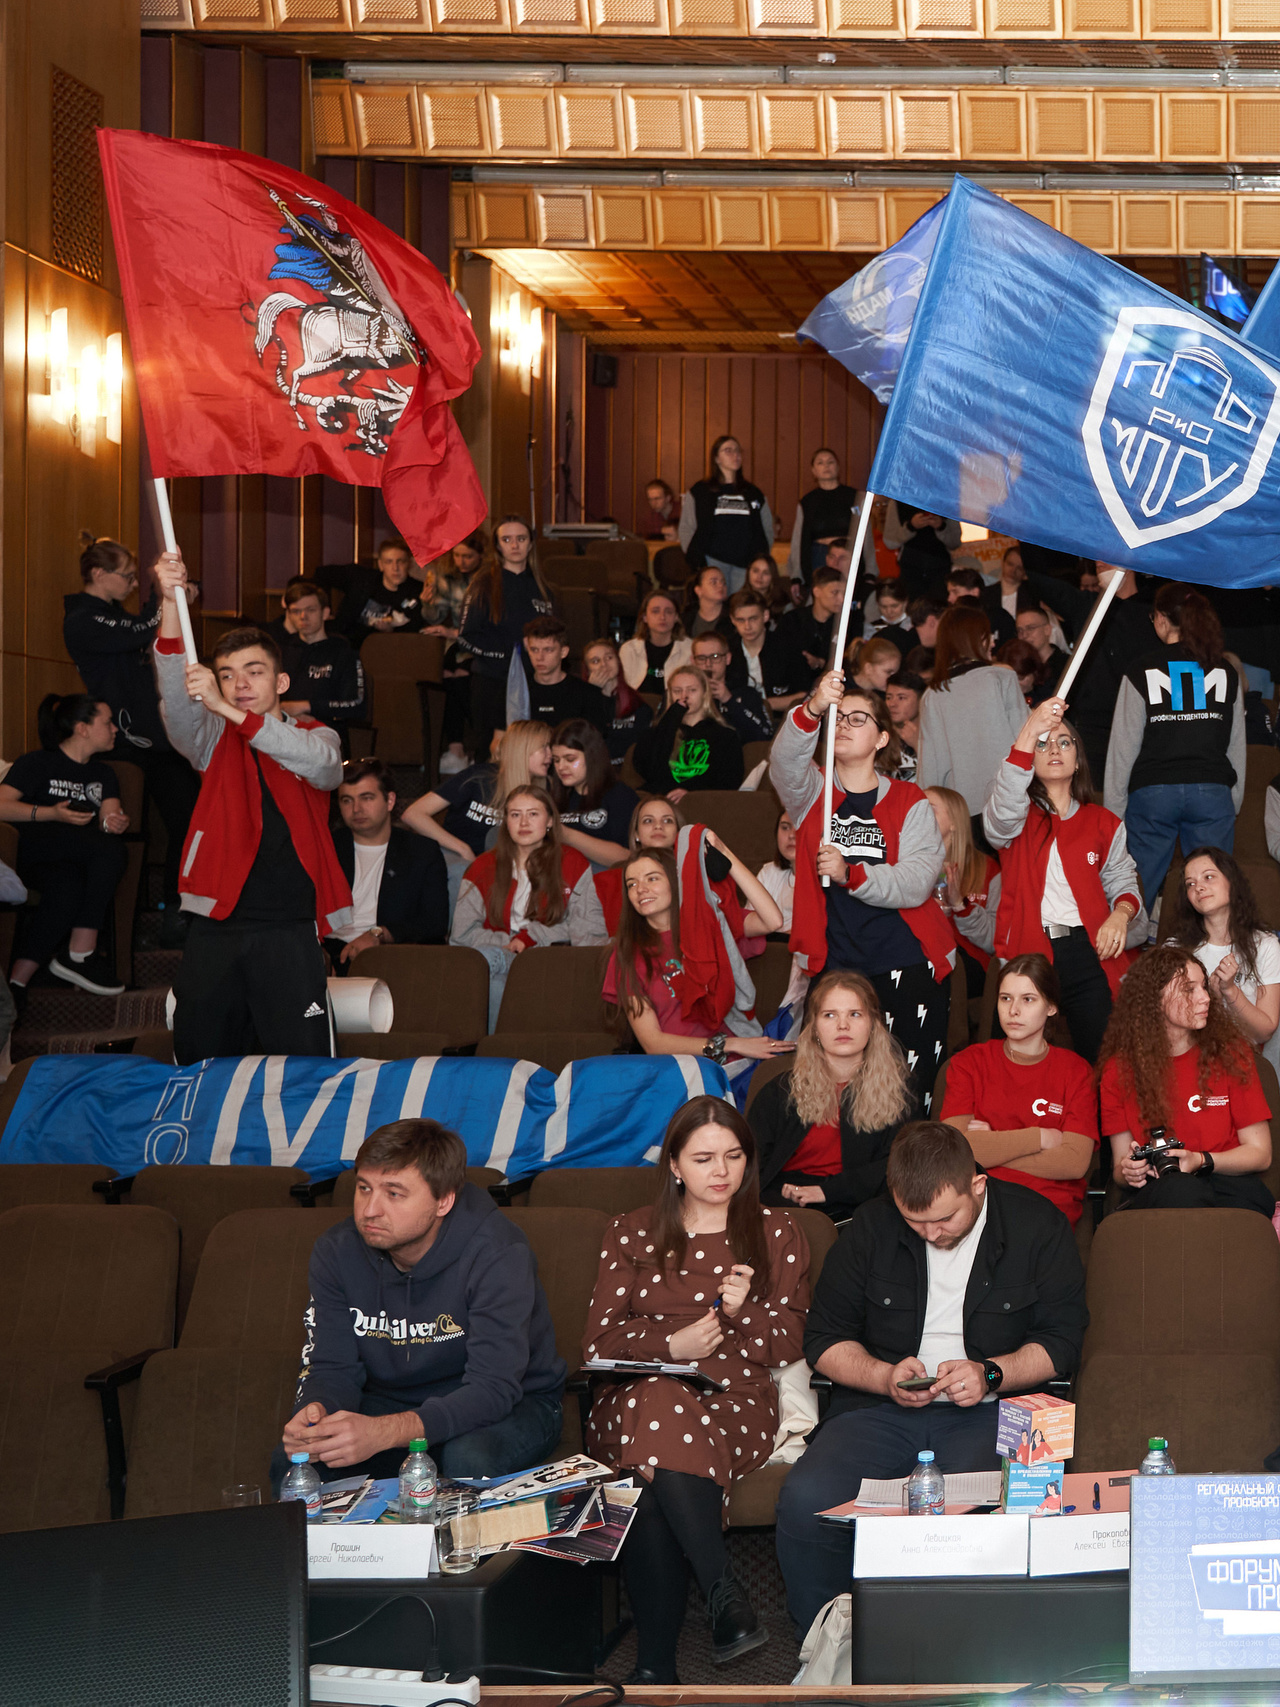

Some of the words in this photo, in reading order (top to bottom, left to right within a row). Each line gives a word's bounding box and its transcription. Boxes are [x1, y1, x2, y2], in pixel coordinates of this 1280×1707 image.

[1150, 714, 1177, 723] ПРОФКОМ
[1177, 712, 1209, 722] СТУДЕНТОВ
[50, 779, 84, 793] ВМЕС
[466, 810, 483, 823] МЫ
[349, 1307, 437, 1340] Quiilver
[1197, 1482, 1275, 1496] РЕГИОНАЛЬНЫЙ
[1223, 1496, 1280, 1509] ПРОФБЮРО
[923, 1532, 962, 1545] Левицкая
[330, 1542, 361, 1554] Прошин
[901, 1544, 921, 1554] Анна
[923, 1543, 983, 1554] Александровна
[1074, 1541, 1107, 1551] Алексей
[338, 1552, 384, 1564] Николаевич
